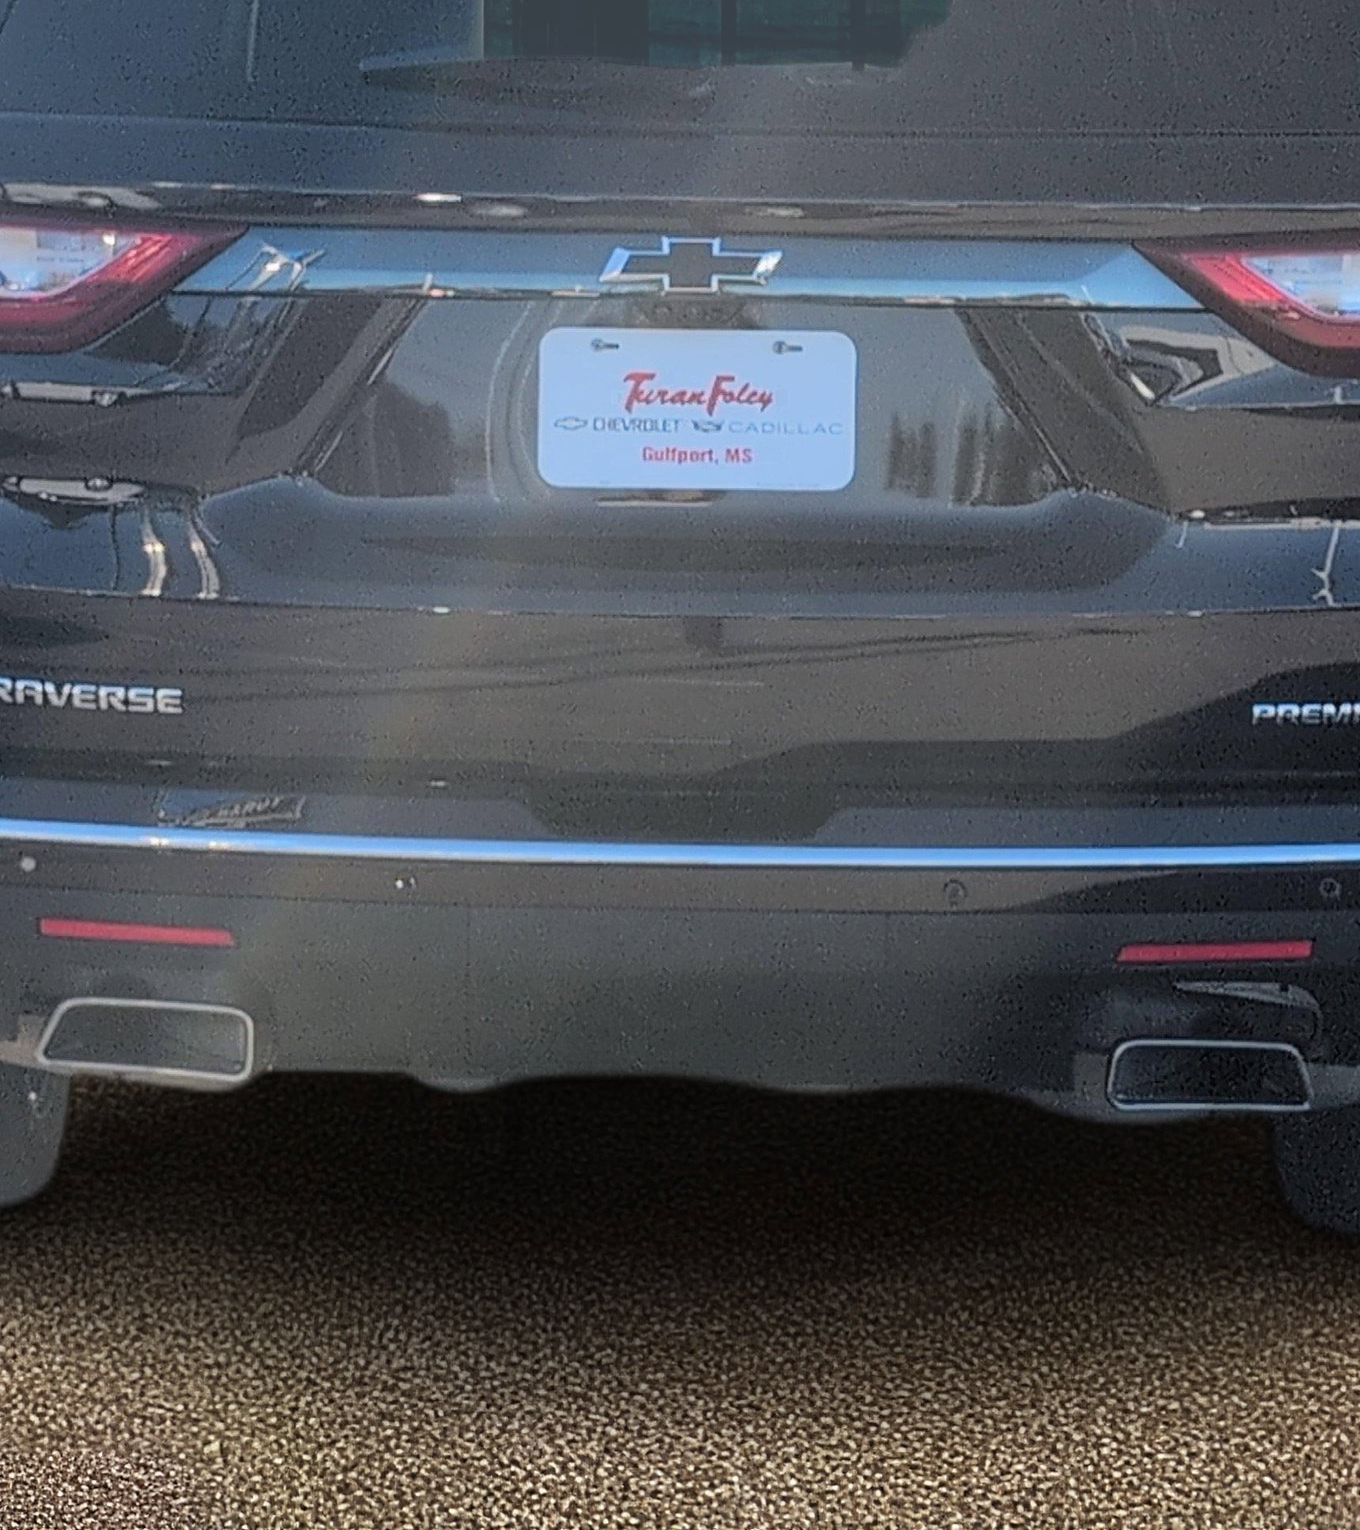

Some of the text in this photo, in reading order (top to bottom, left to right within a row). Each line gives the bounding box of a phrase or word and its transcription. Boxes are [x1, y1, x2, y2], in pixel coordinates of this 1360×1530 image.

[593, 417, 844, 435] CHEVROLET CADILLAC
[642, 447, 752, 465] Gulfport, MS
